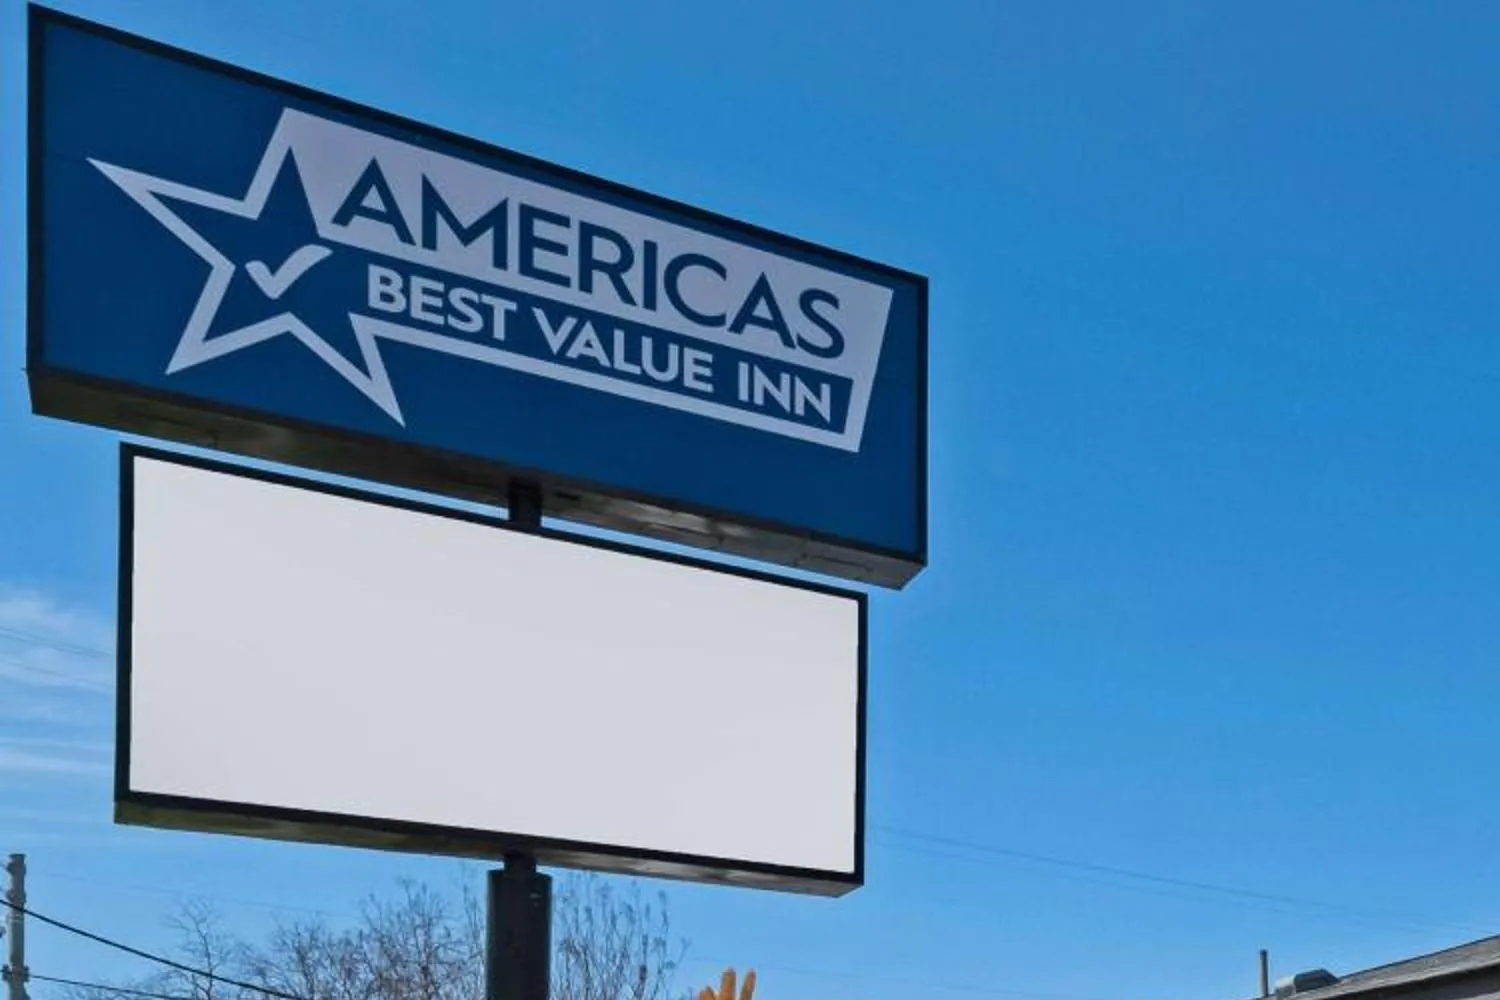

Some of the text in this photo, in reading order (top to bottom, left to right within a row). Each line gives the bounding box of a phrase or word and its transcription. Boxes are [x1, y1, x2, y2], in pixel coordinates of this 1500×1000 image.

[331, 157, 845, 359] AMERICAS
[367, 265, 832, 424] BEST VALUE INN
